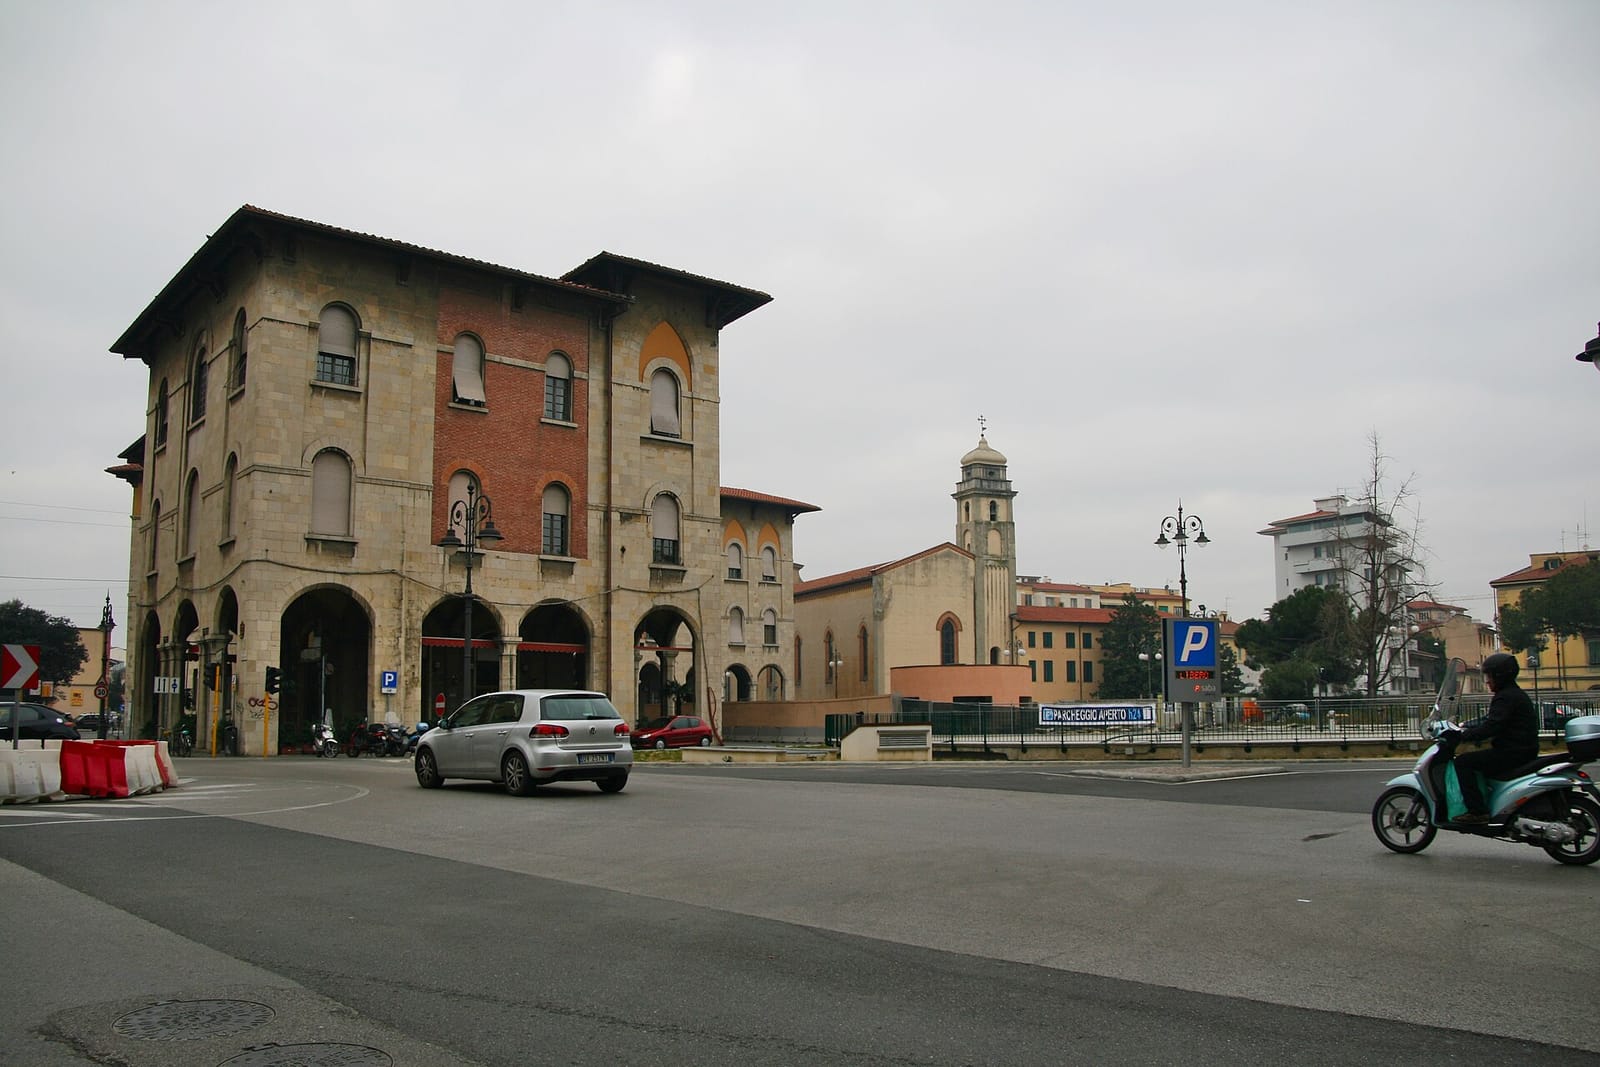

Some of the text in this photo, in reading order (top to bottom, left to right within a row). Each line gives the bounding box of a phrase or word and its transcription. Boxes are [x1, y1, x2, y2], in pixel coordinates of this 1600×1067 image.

[1180, 625, 1209, 662] P
[385, 673, 394, 686] P
[1053, 708, 1098, 721] PARCHEGGIO
[1099, 708, 1127, 721] APERTO
[1128, 707, 1142, 720] h24
